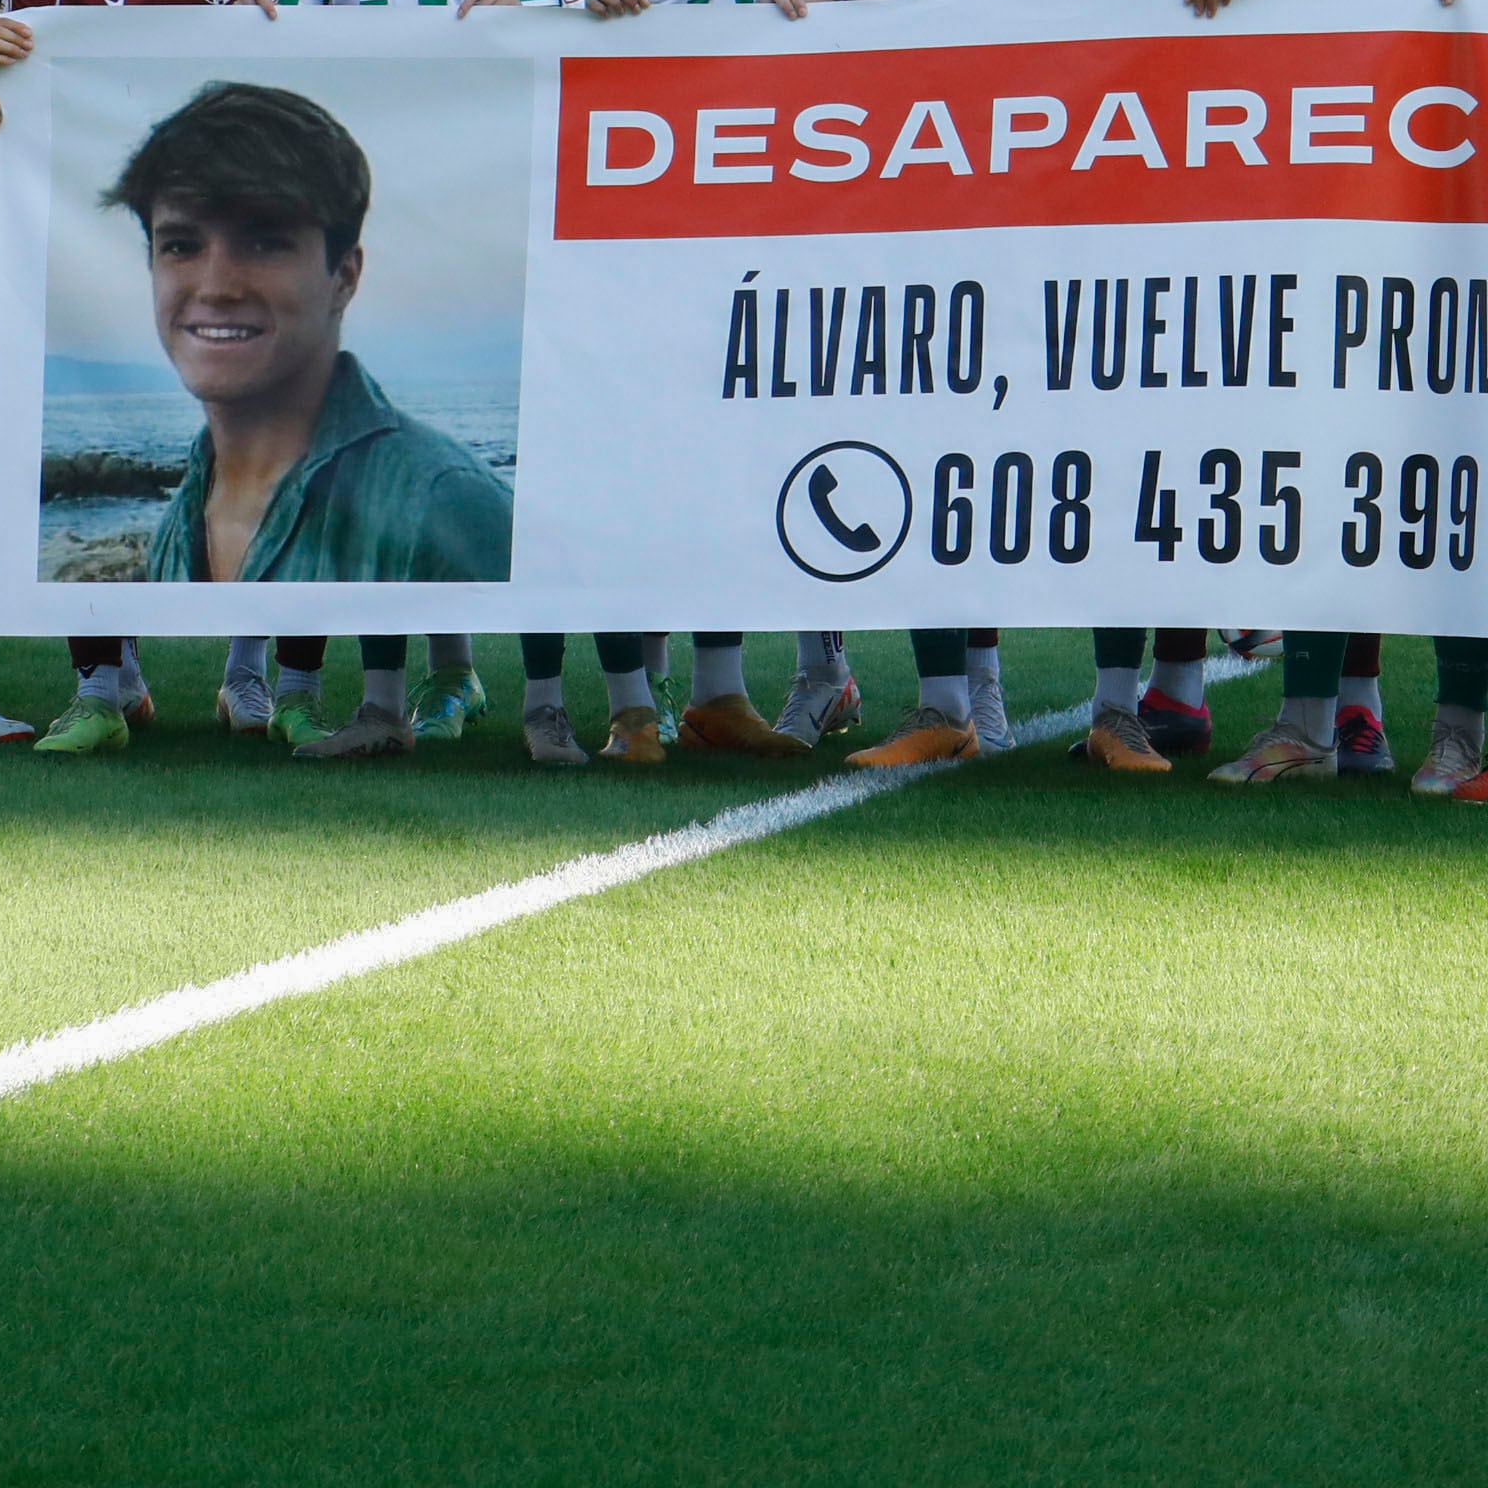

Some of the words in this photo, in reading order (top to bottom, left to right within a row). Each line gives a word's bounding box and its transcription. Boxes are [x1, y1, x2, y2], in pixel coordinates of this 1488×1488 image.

[721, 270, 1009, 411] ÁLVARO,
[1043, 274, 1299, 391] VUELVE
[930, 449, 1093, 567] 608
[1134, 448, 1302, 567] 435
[1340, 453, 1480, 573] 399
